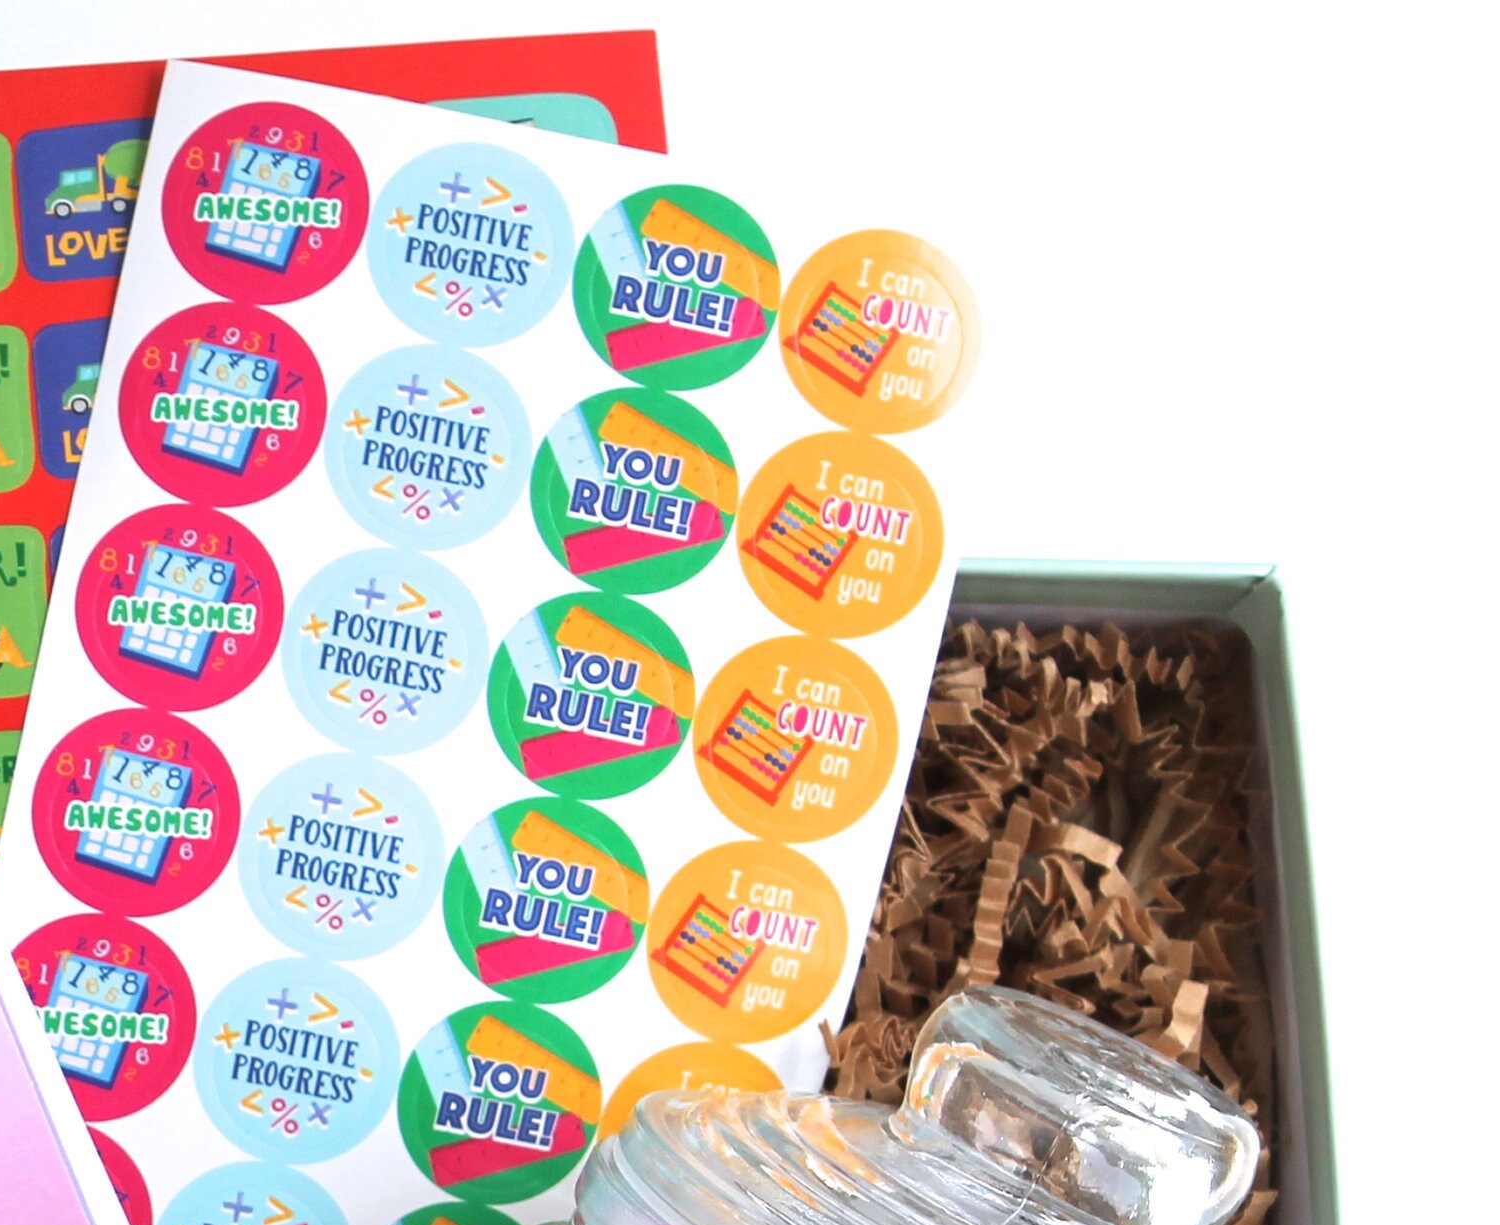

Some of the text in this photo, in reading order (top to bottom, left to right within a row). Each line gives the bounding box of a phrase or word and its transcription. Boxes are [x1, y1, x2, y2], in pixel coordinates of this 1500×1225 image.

[196, 195, 339, 226] AWESOME!
[417, 204, 532, 251] POSITIVE
[45, 227, 128, 267] LOVE
[405, 237, 530, 286] PROGRESS
[646, 241, 722, 283] YOU
[612, 276, 735, 332] RULE!
[880, 271, 925, 298] can
[863, 294, 952, 339] COUNT
[907, 348, 935, 369] on
[880, 369, 923, 399] you
[153, 396, 296, 427] AWESOME!
[375, 407, 490, 454] POSITIVE
[363, 440, 488, 489] PROGRESS
[604, 444, 680, 486] YOU
[839, 473, 884, 500] can
[570, 480, 693, 536] RULE!
[822, 497, 911, 542] COUNT
[866, 551, 894, 572] on
[838, 572, 881, 602] you
[110, 600, 253, 631] AWESOME!
[332, 611, 447, 658] POSITIVE
[320, 644, 445, 693] PROGRESS
[561, 649, 637, 691] YOU
[526, 684, 649, 740] RULE!
[795, 678, 840, 705] can
[778, 702, 867, 747] COUNT
[821, 756, 849, 777] on
[792, 777, 835, 807] you
[67, 805, 210, 836] AWESOME!
[288, 816, 403, 863] POSITIVE
[276, 849, 401, 898] PROGRESS
[516, 854, 592, 896] YOU
[748, 882, 793, 909] can
[482, 889, 605, 945] RULE!
[730, 906, 819, 951] COUNT
[771, 958, 799, 979] on
[743, 979, 786, 1009] you
[36, 1009, 167, 1042] WESOME!
[244, 1021, 359, 1068] POSITIVE
[231, 1054, 356, 1103] PROGRESS
[470, 1057, 546, 1099] YOU
[436, 1092, 556, 1147] RULE!
